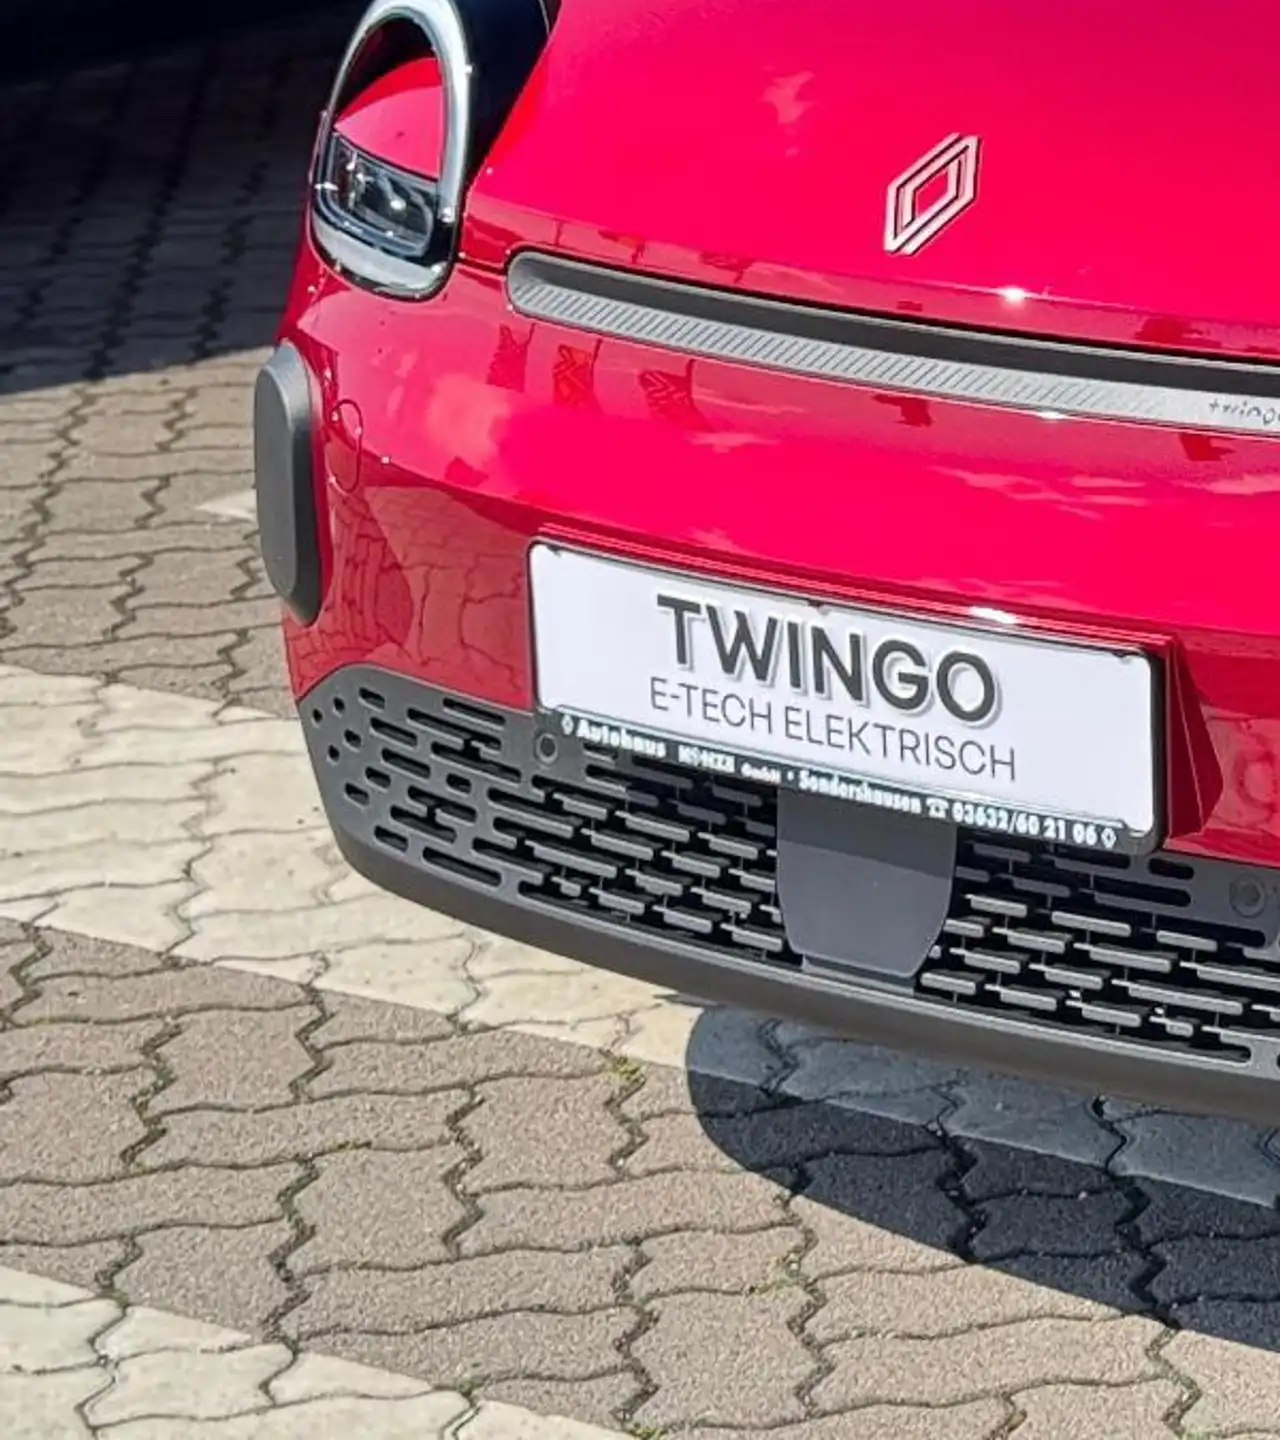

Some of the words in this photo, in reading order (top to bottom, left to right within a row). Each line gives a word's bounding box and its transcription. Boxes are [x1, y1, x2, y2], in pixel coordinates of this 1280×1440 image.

[657, 594, 997, 724] TWINGO
[575, 717, 668, 760] Autohaus
[799, 768, 922, 815] Sondershausen
[650, 676, 773, 735] E-TECH
[784, 706, 1016, 782] ELEKTRISCH
